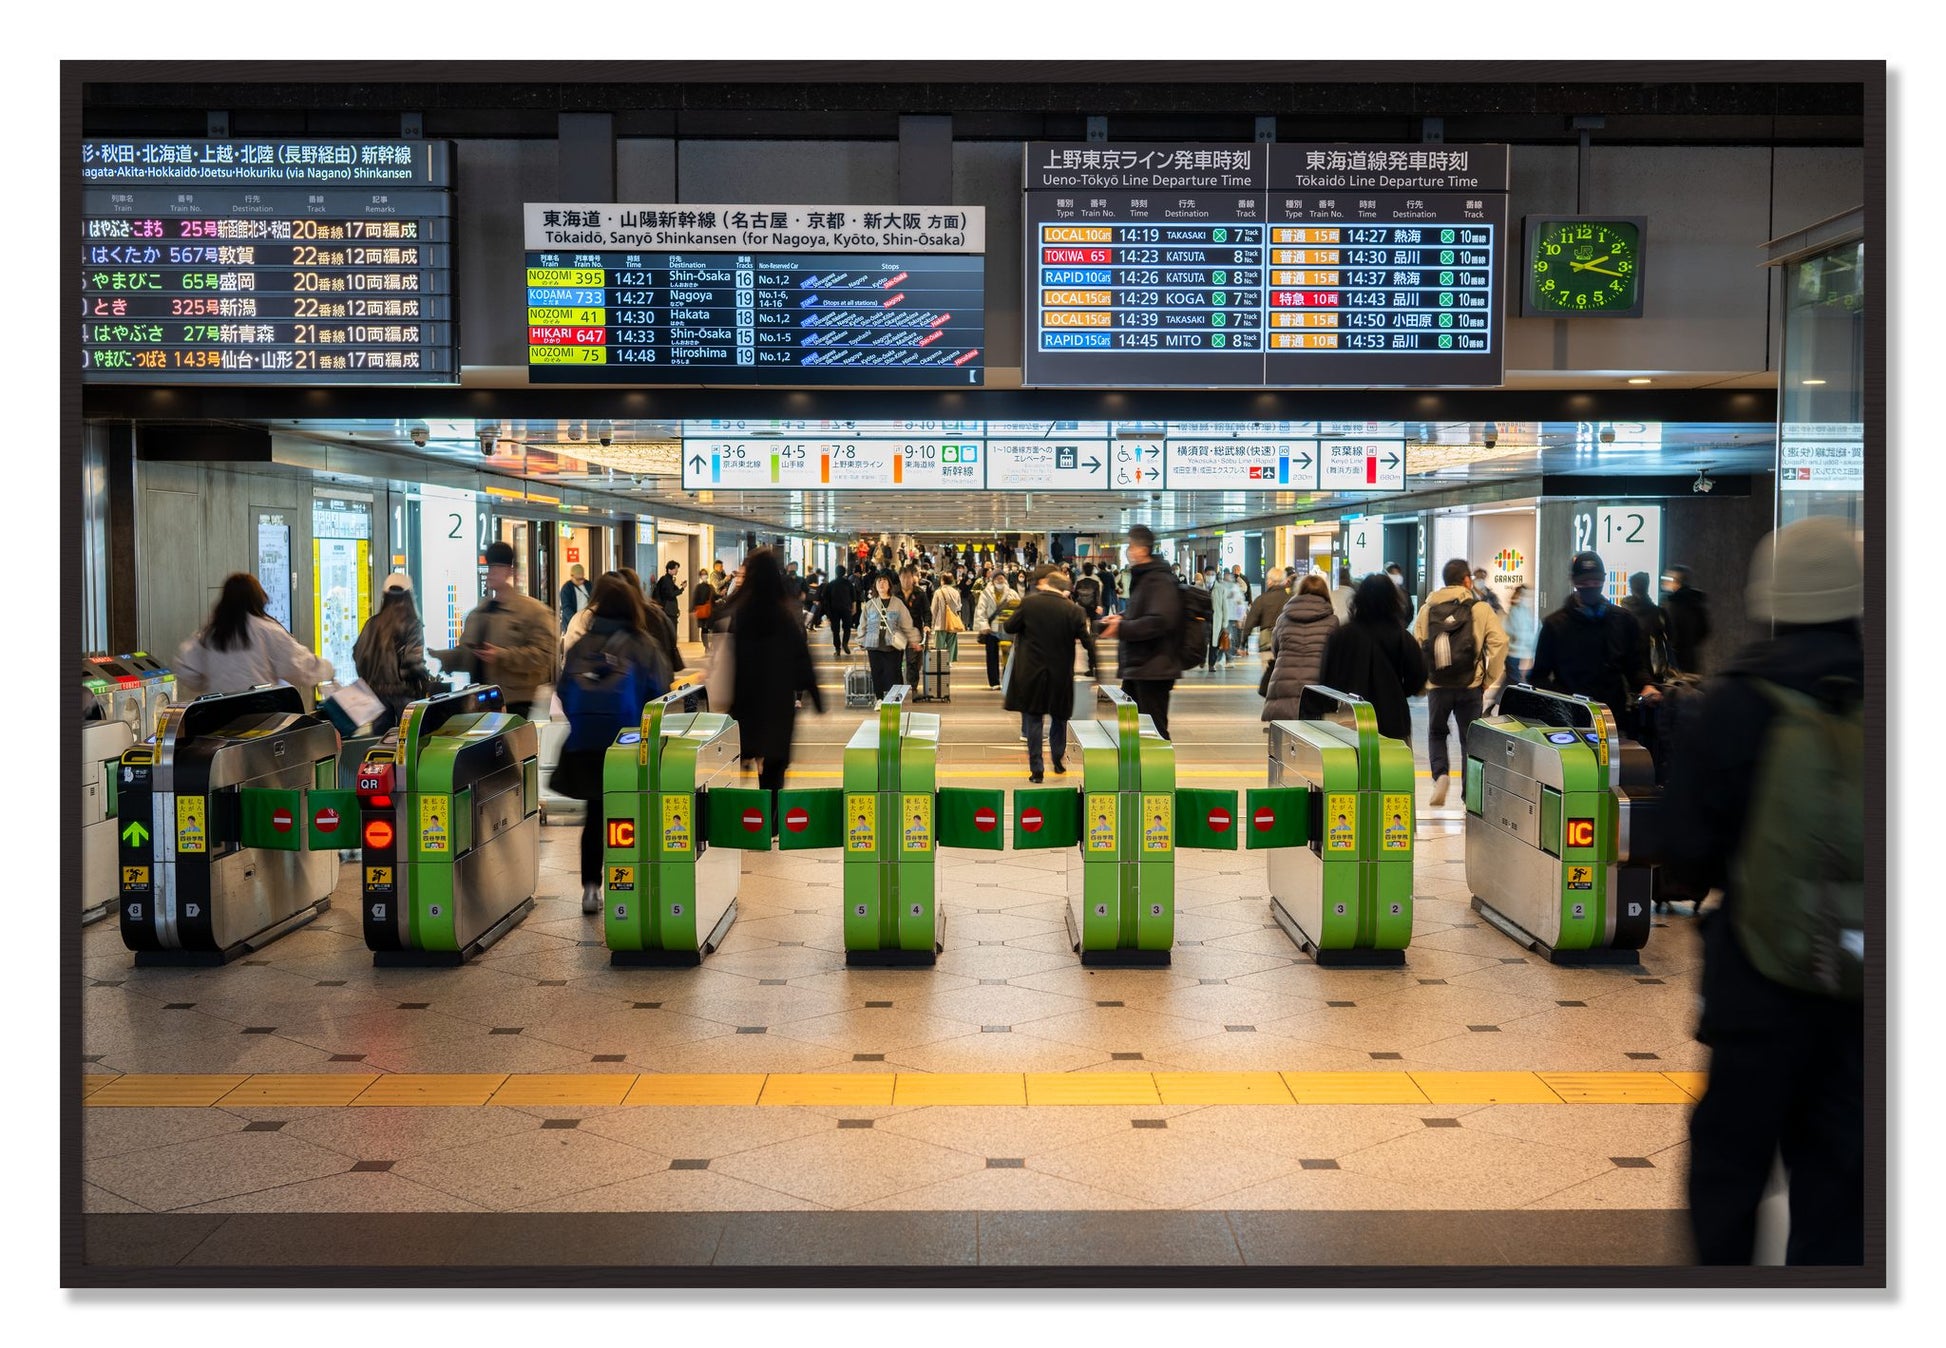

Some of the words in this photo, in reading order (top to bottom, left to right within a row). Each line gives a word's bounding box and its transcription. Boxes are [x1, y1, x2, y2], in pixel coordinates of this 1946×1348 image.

[1043, 150, 1251, 170] 上野東京ライン発車時刻
[1306, 151, 1469, 171] 東海道線発車時刻
[286, 168, 304, 180] (via
[307, 168, 351, 180] Nagano)
[354, 168, 412, 179] Shinkansen
[1043, 174, 1119, 189] Ueno-Tōkyō
[1123, 174, 1149, 186] Line
[1152, 174, 1217, 188] Departure
[1221, 174, 1252, 187] Time
[1295, 174, 1346, 187] Tōkaidō
[1350, 175, 1376, 187] Line
[1379, 175, 1444, 189] Departure
[1448, 175, 1479, 187] Time
[1056, 210, 1074, 218] Type
[181, 221, 218, 237] 25号
[346, 222, 417, 239] 17両編成
[1045, 230, 1084, 241] LOCAL
[1119, 229, 1160, 242] 14:19
[1166, 231, 1206, 240] TAKASAKI
[1234, 229, 1243, 242] 7
[1281, 229, 1306, 242] 普通
[1314, 230, 1339, 242] 15両
[1576, 228, 1592, 239] 12
[546, 231, 607, 246] Tōkaidō,
[610, 231, 653, 248] Sanyō
[657, 231, 737, 245] Shinkansen
[743, 232, 768, 246] (for
[773, 233, 830, 248] Nagoya,
[834, 234, 879, 248] Kyōto,
[883, 233, 966, 247] Shin-Ōsaka)
[1347, 229, 1387, 243] 14:27
[1394, 229, 1422, 244] 熱海
[92, 246, 160, 263] はくたか
[170, 247, 218, 263] 567号
[218, 246, 255, 265] 敦賀
[1046, 250, 1084, 261] TOKIWA
[1091, 250, 1105, 261] 65
[1119, 249, 1158, 263] 14:23
[1166, 251, 1205, 262] KATSUTA
[1347, 250, 1387, 264] 14:30
[1394, 250, 1420, 265] 品川
[882, 263, 899, 271] Stops
[92, 273, 162, 289] やまびこ
[182, 273, 219, 290] 65号
[219, 273, 255, 291] 盛岡
[529, 270, 572, 281] NOZOMI
[576, 272, 602, 285] 395
[615, 272, 653, 285] 14:21
[669, 270, 731, 281] Shin-Ōsaka
[737, 273, 751, 286] 16
[759, 275, 790, 286] No.1,2
[1045, 271, 1084, 282] RAPID
[1119, 270, 1159, 284] 14:26
[1166, 272, 1205, 283] KATSUTA
[1346, 271, 1386, 285] 14:37
[529, 289, 572, 300] KODAMA
[576, 291, 602, 304] 733
[615, 291, 654, 305] 14:27
[670, 290, 713, 302] Nagoya
[759, 290, 789, 301] No.1-6,
[1119, 291, 1158, 305] 14:29
[1166, 293, 1205, 304] KOGA
[1279, 293, 1305, 306] 特急
[1346, 292, 1386, 306] 14:43
[94, 298, 128, 316] とき
[172, 299, 219, 316] 325号
[219, 298, 256, 317] 新潟
[759, 300, 783, 308] 14-16
[530, 309, 573, 319] NOZOMI
[580, 311, 597, 323] 41
[615, 311, 655, 324] 14:30
[670, 309, 710, 319] Hakata
[1119, 313, 1158, 326] 14:39
[1346, 313, 1386, 327] 14:50
[1392, 313, 1432, 328] 小田原
[94, 325, 164, 342] はやぶさ
[184, 326, 219, 342] 27号
[220, 325, 275, 343] 新青森
[532, 328, 572, 338] HIKARI
[576, 329, 603, 343] 647
[616, 330, 655, 343] 14:33
[671, 327, 731, 339] Shin-Ōsaka
[1045, 335, 1084, 346] RAPID
[1119, 333, 1158, 347] 14:45
[1166, 335, 1202, 346] MITO
[1345, 334, 1385, 348] 14:53
[1392, 335, 1418, 349] 品川
[531, 346, 574, 357] NOZOMI
[582, 349, 599, 362] 75
[616, 349, 656, 362] 14:48
[671, 347, 727, 358] Hiroshima
[174, 351, 221, 368] 143号
[221, 351, 293, 369] 仙台・山形
[1331, 446, 1363, 456] 京葉線
[781, 460, 804, 469] 山手線
[832, 460, 883, 469] 上野東京ライン
[904, 460, 936, 469] 東海道線
[942, 466, 974, 477] 新幹線
[395, 505, 402, 550] 1
[448, 513, 463, 539] 2
[479, 513, 488, 551] 2
[1604, 513, 1645, 543] 1·2
[1356, 532, 1367, 549] 4
[1418, 524, 1425, 555] 3
[1226, 543, 1234, 554] 6
[1494, 574, 1524, 583] GRANSTA
[361, 779, 378, 789] QR
[610, 823, 634, 845] IC
[1569, 822, 1592, 845] IC
[132, 905, 139, 914] 8
[189, 906, 195, 914] 7
[376, 906, 383, 914] 7
[432, 906, 438, 915] 6
[618, 906, 624, 914] 6
[673, 905, 680, 914] 5
[913, 906, 919, 914] 4
[1153, 905, 1160, 914] 3
[1392, 905, 1399, 913] 2
[1575, 905, 1582, 914] 2
